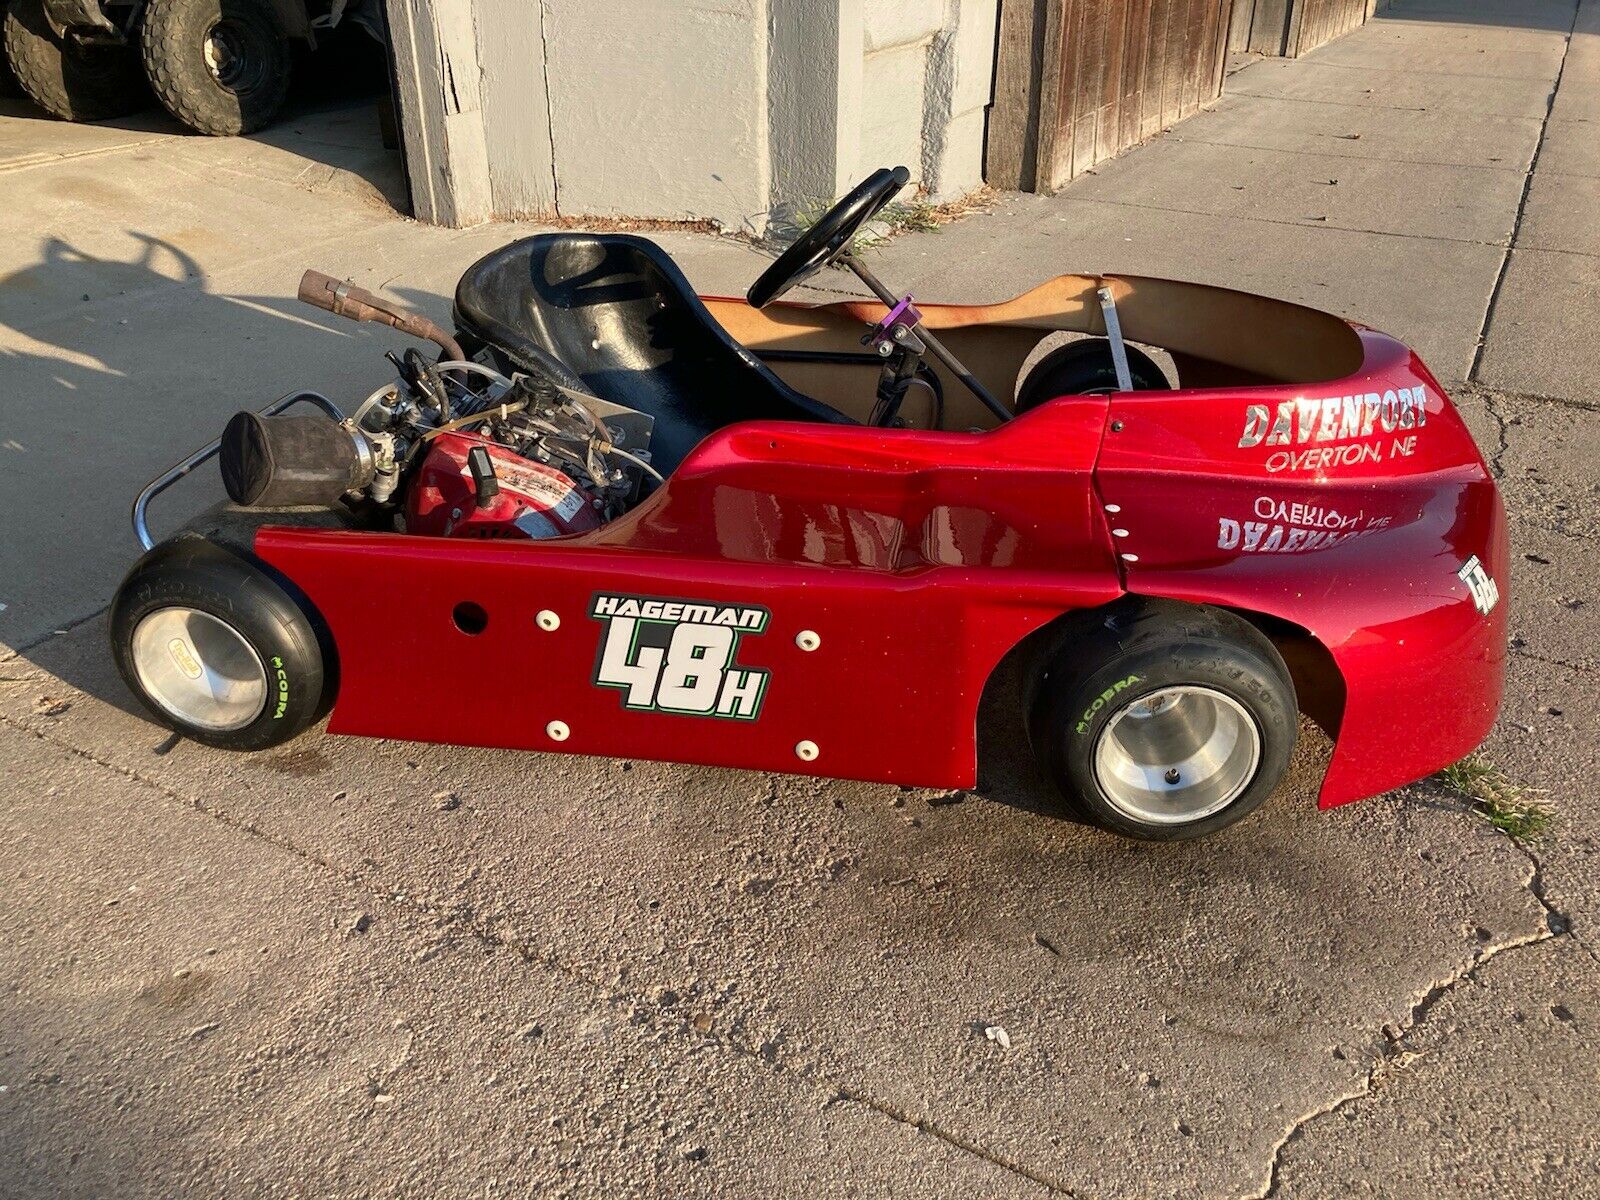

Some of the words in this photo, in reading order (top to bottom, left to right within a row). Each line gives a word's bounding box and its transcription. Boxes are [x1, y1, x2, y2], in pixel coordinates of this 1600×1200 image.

[1238, 384, 1427, 448] DAVENPORT
[1265, 441, 1382, 473] OVERTON,
[1390, 436, 1418, 459] NE
[594, 596, 765, 629] HAGEMAN
[272, 669, 289, 719] COBRA
[1083, 674, 1140, 721] COBRA
